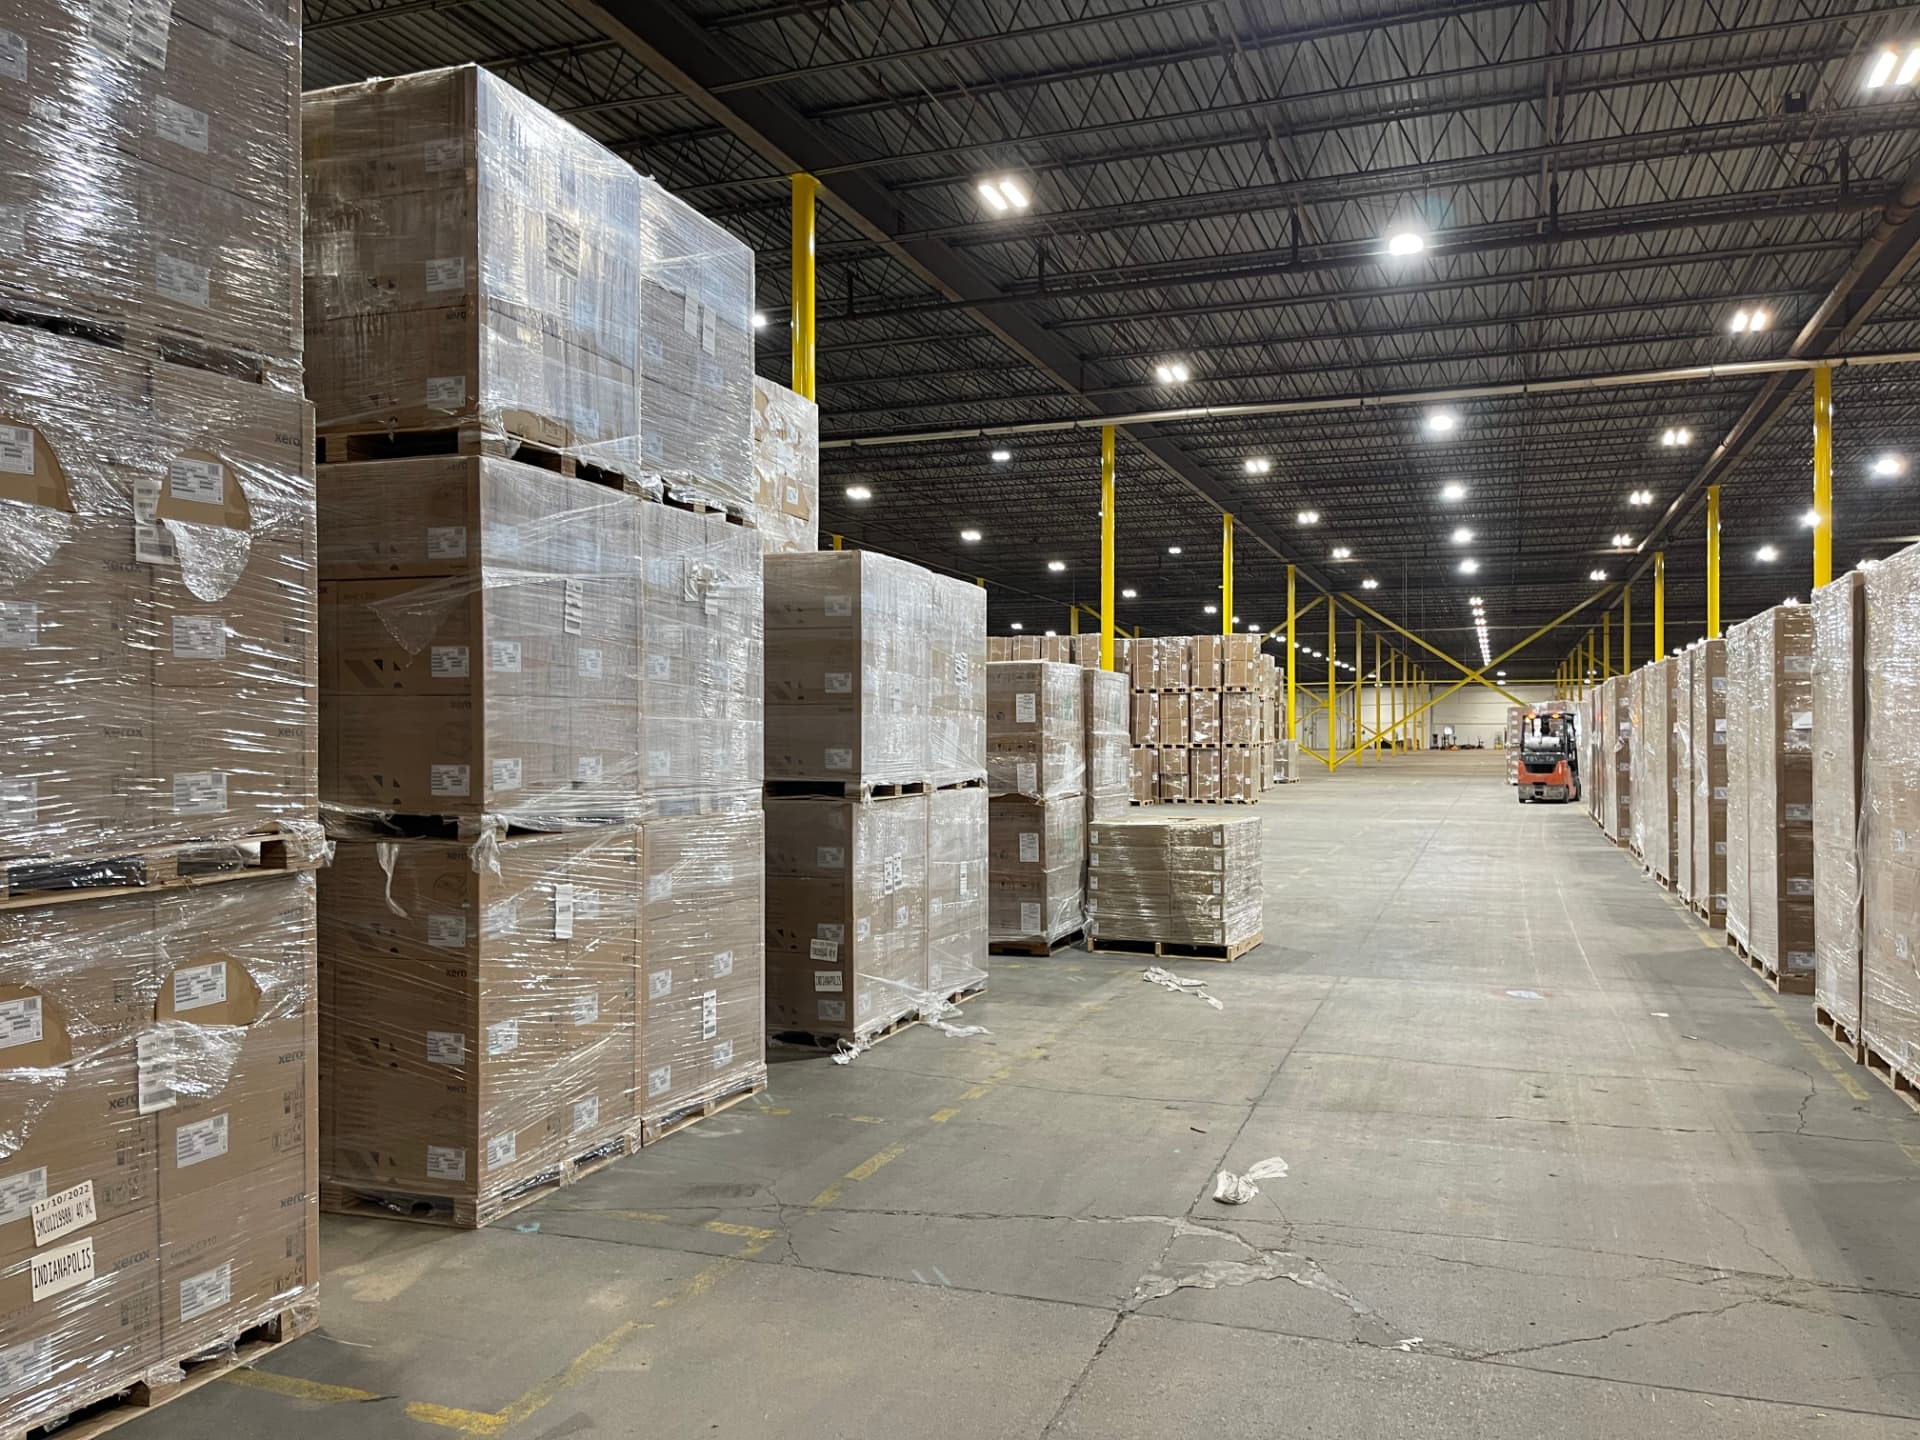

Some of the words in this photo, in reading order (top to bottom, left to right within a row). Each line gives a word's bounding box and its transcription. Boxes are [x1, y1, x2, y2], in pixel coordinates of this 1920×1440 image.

[275, 432, 302, 446] xero
[103, 727, 143, 738] xerox
[278, 726, 304, 737] xero
[446, 968, 468, 978] xero
[278, 1049, 305, 1065] xero
[108, 1094, 139, 1110] xero
[34, 1184, 89, 1215] 11/10/2022
[280, 1191, 305, 1209] xero
[32, 1247, 92, 1289] INDIANAPOLIS
[112, 1249, 151, 1272] xerox
